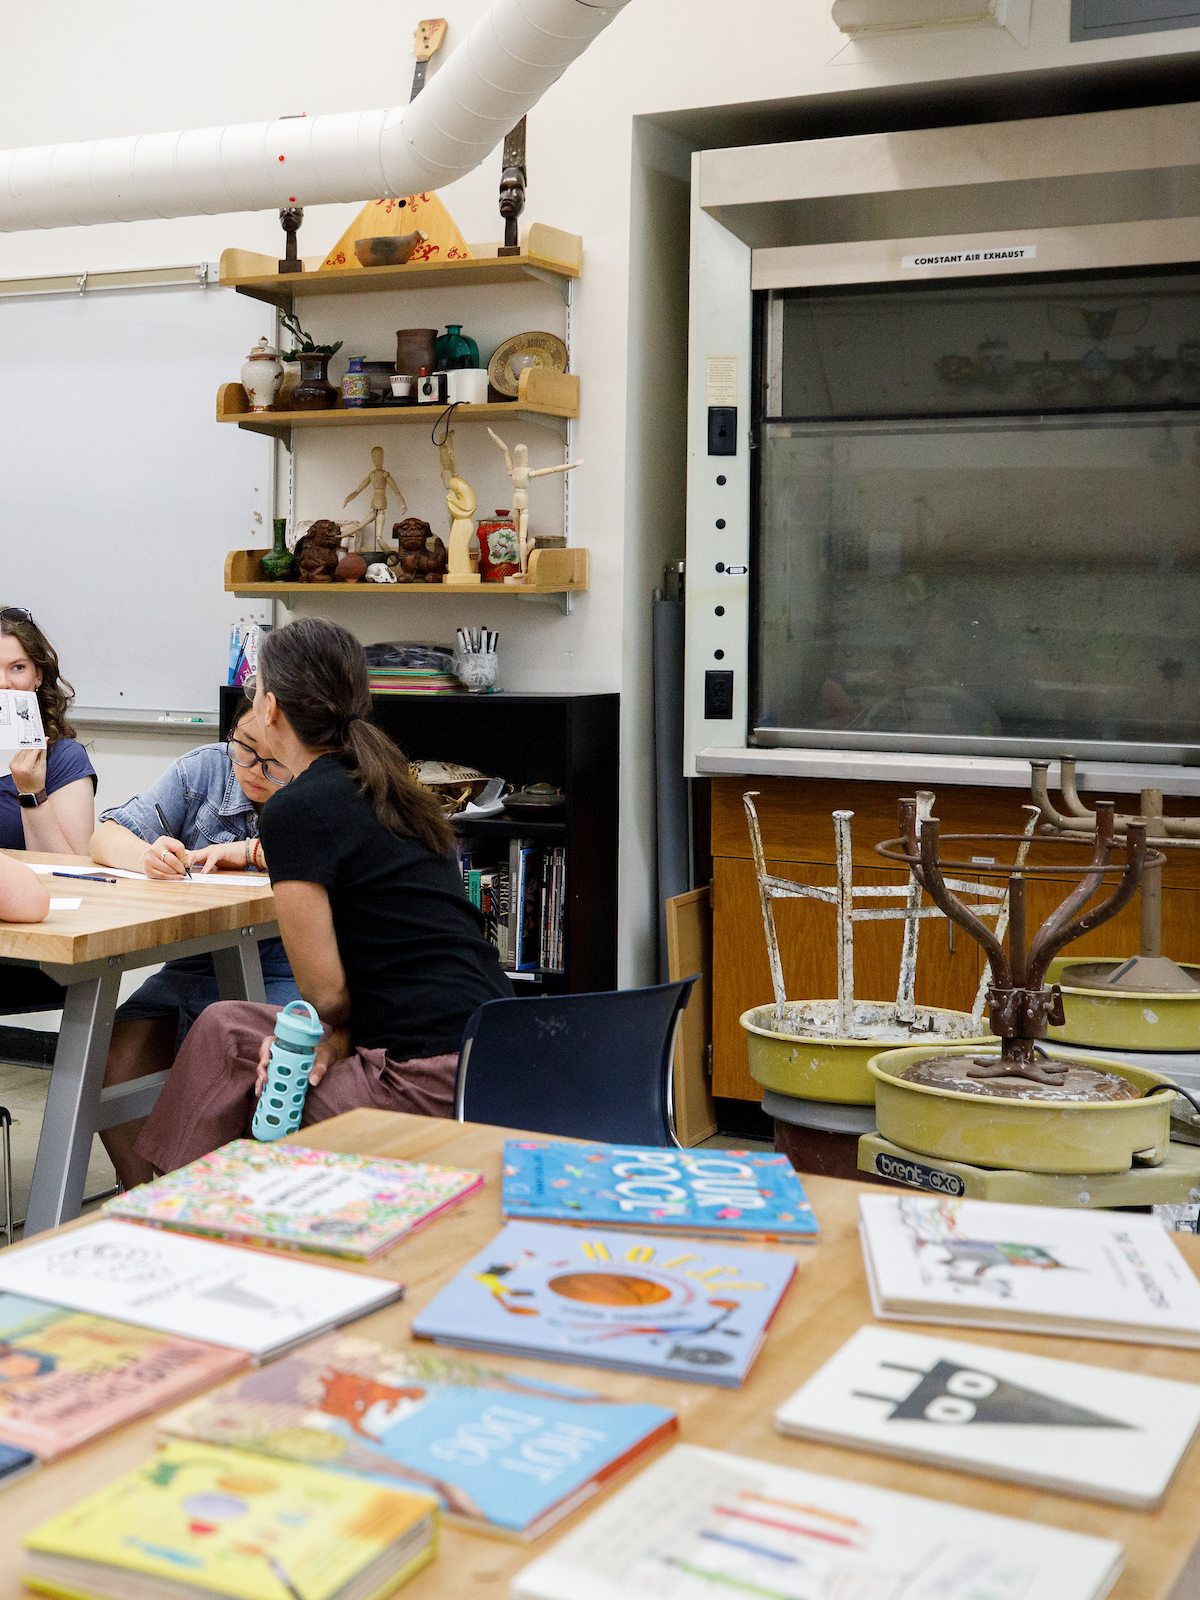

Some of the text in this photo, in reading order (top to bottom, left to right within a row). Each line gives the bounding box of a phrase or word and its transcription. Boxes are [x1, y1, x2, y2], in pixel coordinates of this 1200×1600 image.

[914, 250, 1025, 266] CONSTANT AIR EXHAUST
[499, 872, 510, 917] AFRICA
[611, 1149, 693, 1216] POOL
[685, 1158, 767, 1210] OUR
[881, 1155, 923, 1182] brent
[430, 1404, 545, 1466] DOG
[500, 1421, 609, 1485] HOT
